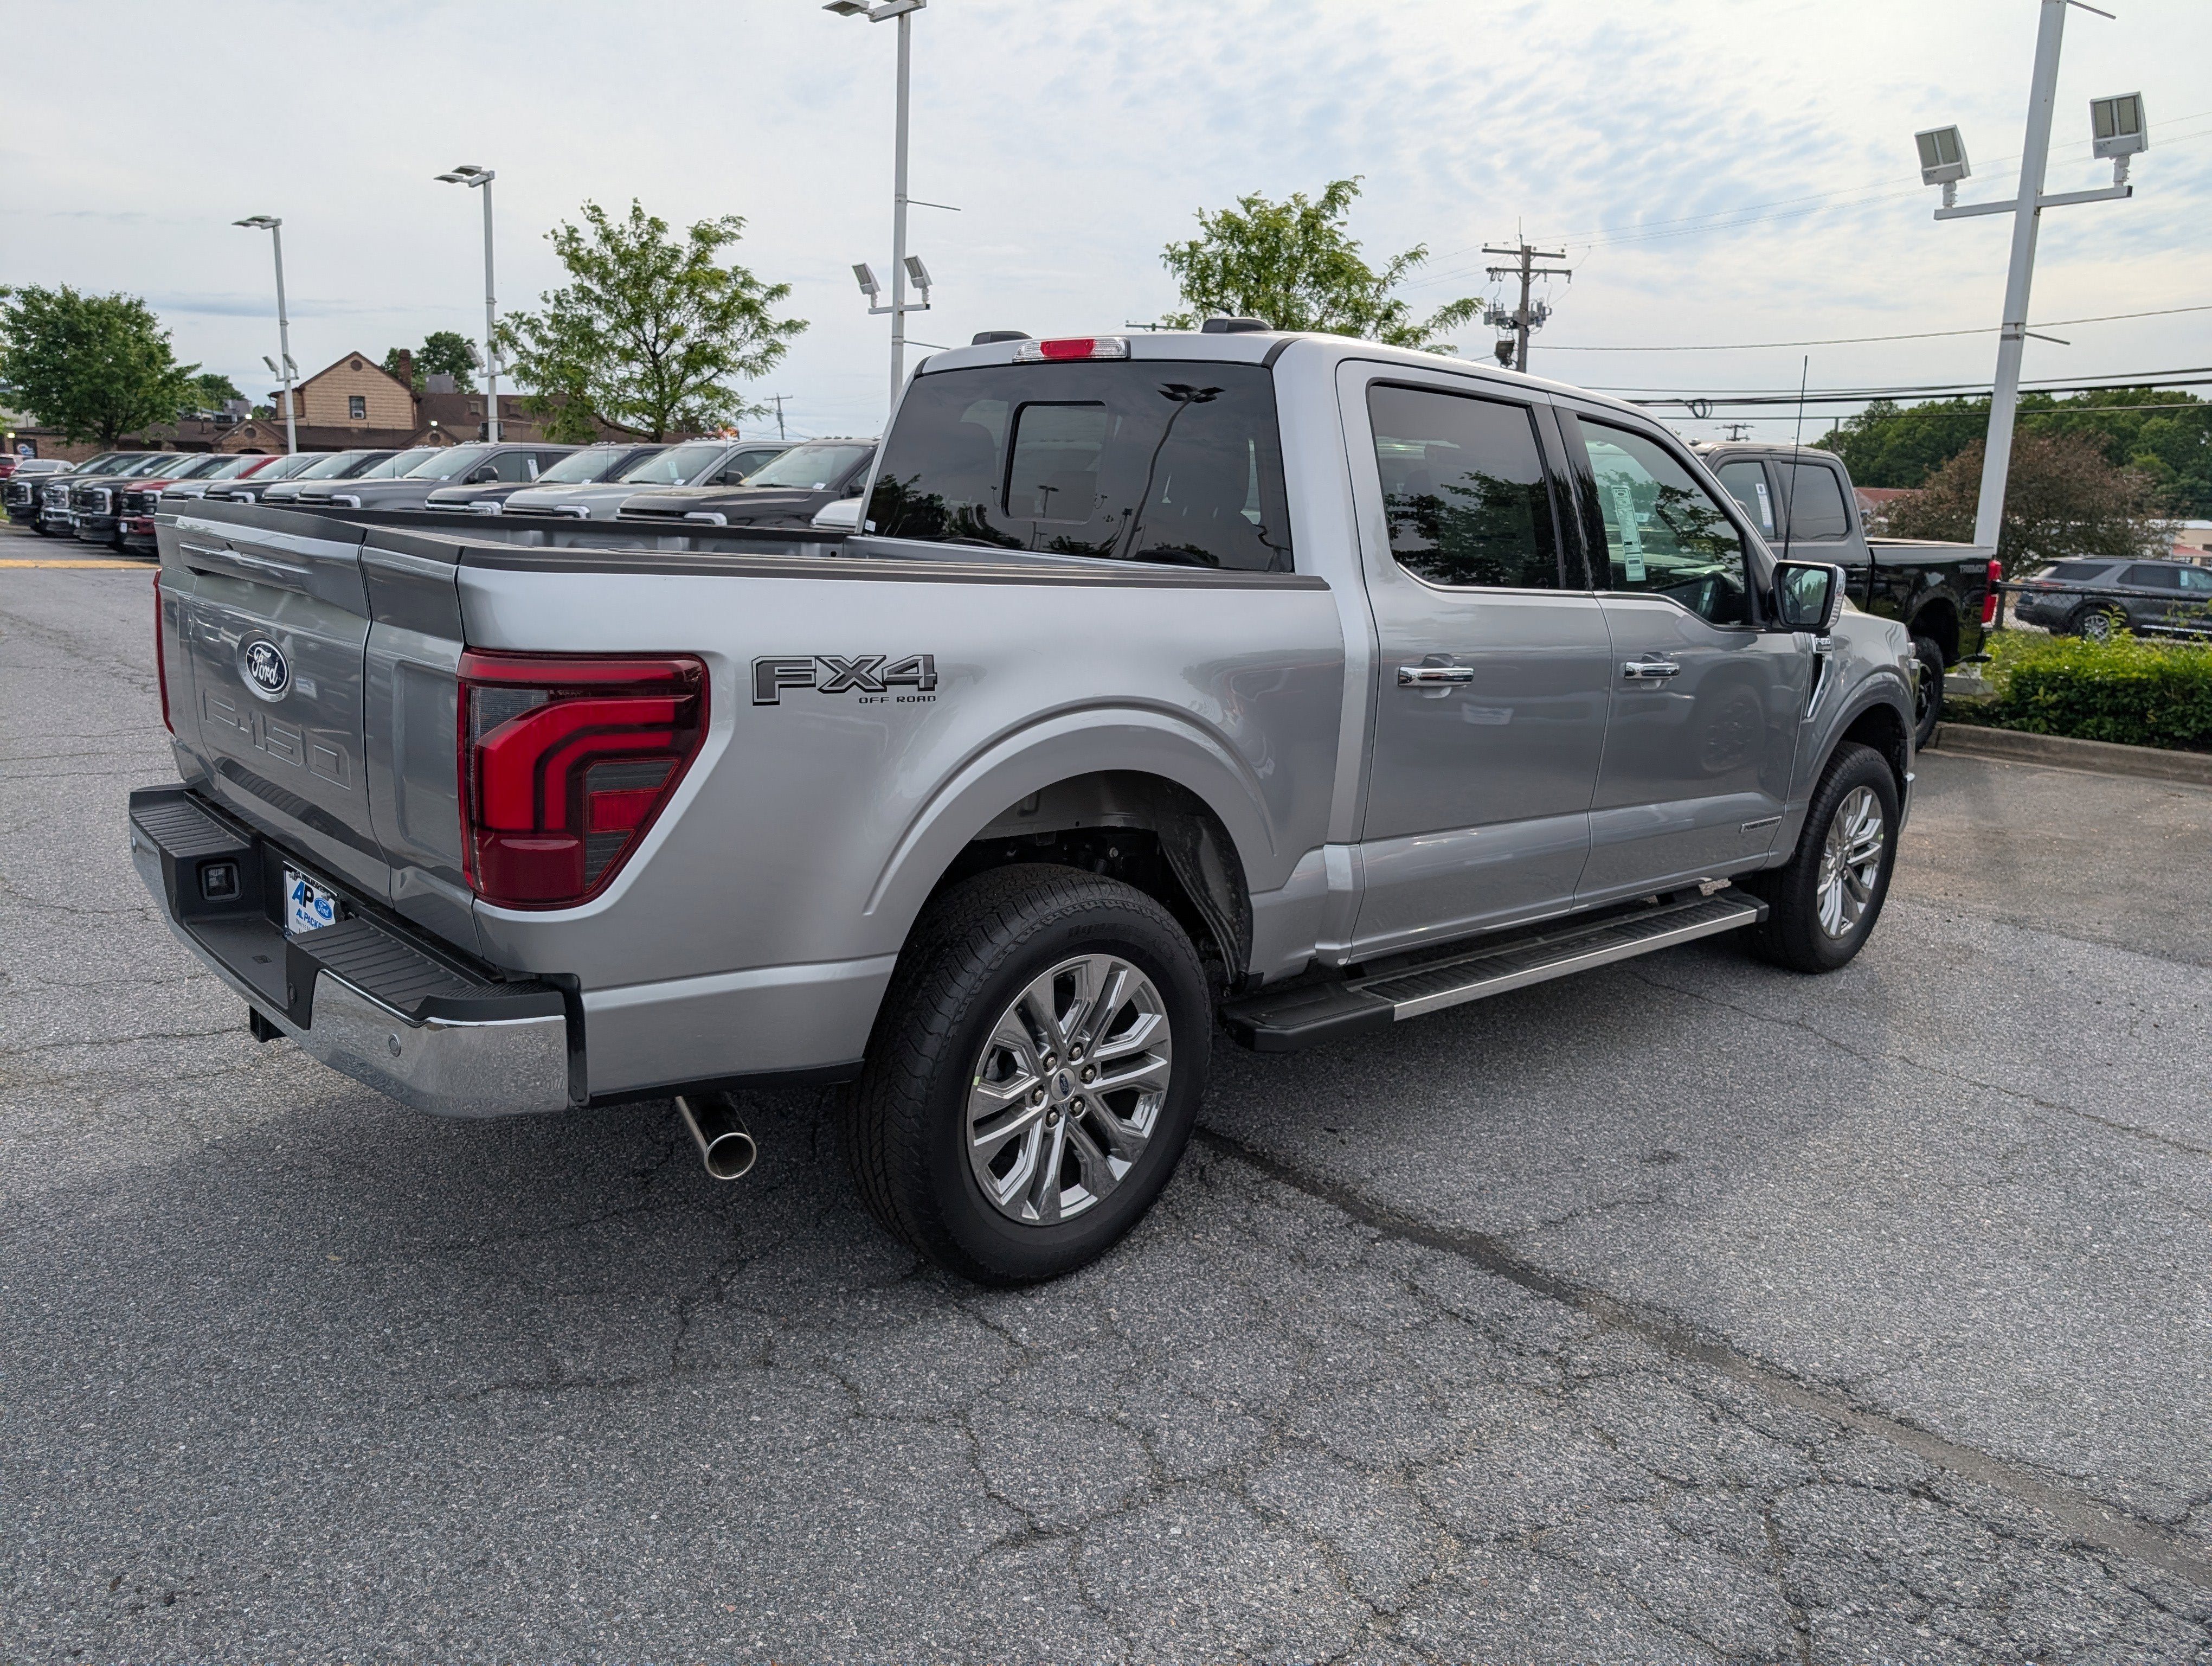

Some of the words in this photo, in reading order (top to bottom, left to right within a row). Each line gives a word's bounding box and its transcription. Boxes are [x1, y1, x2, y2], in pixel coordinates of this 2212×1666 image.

[252, 646, 279, 685] Ford
[751, 653, 938, 707] FX4
[859, 696, 890, 704] OFF
[896, 695, 937, 703] ROAD
[202, 688, 352, 791] F-150
[292, 880, 314, 908] AP
[304, 912, 325, 930] PACKE
[317, 900, 330, 917] Ford
